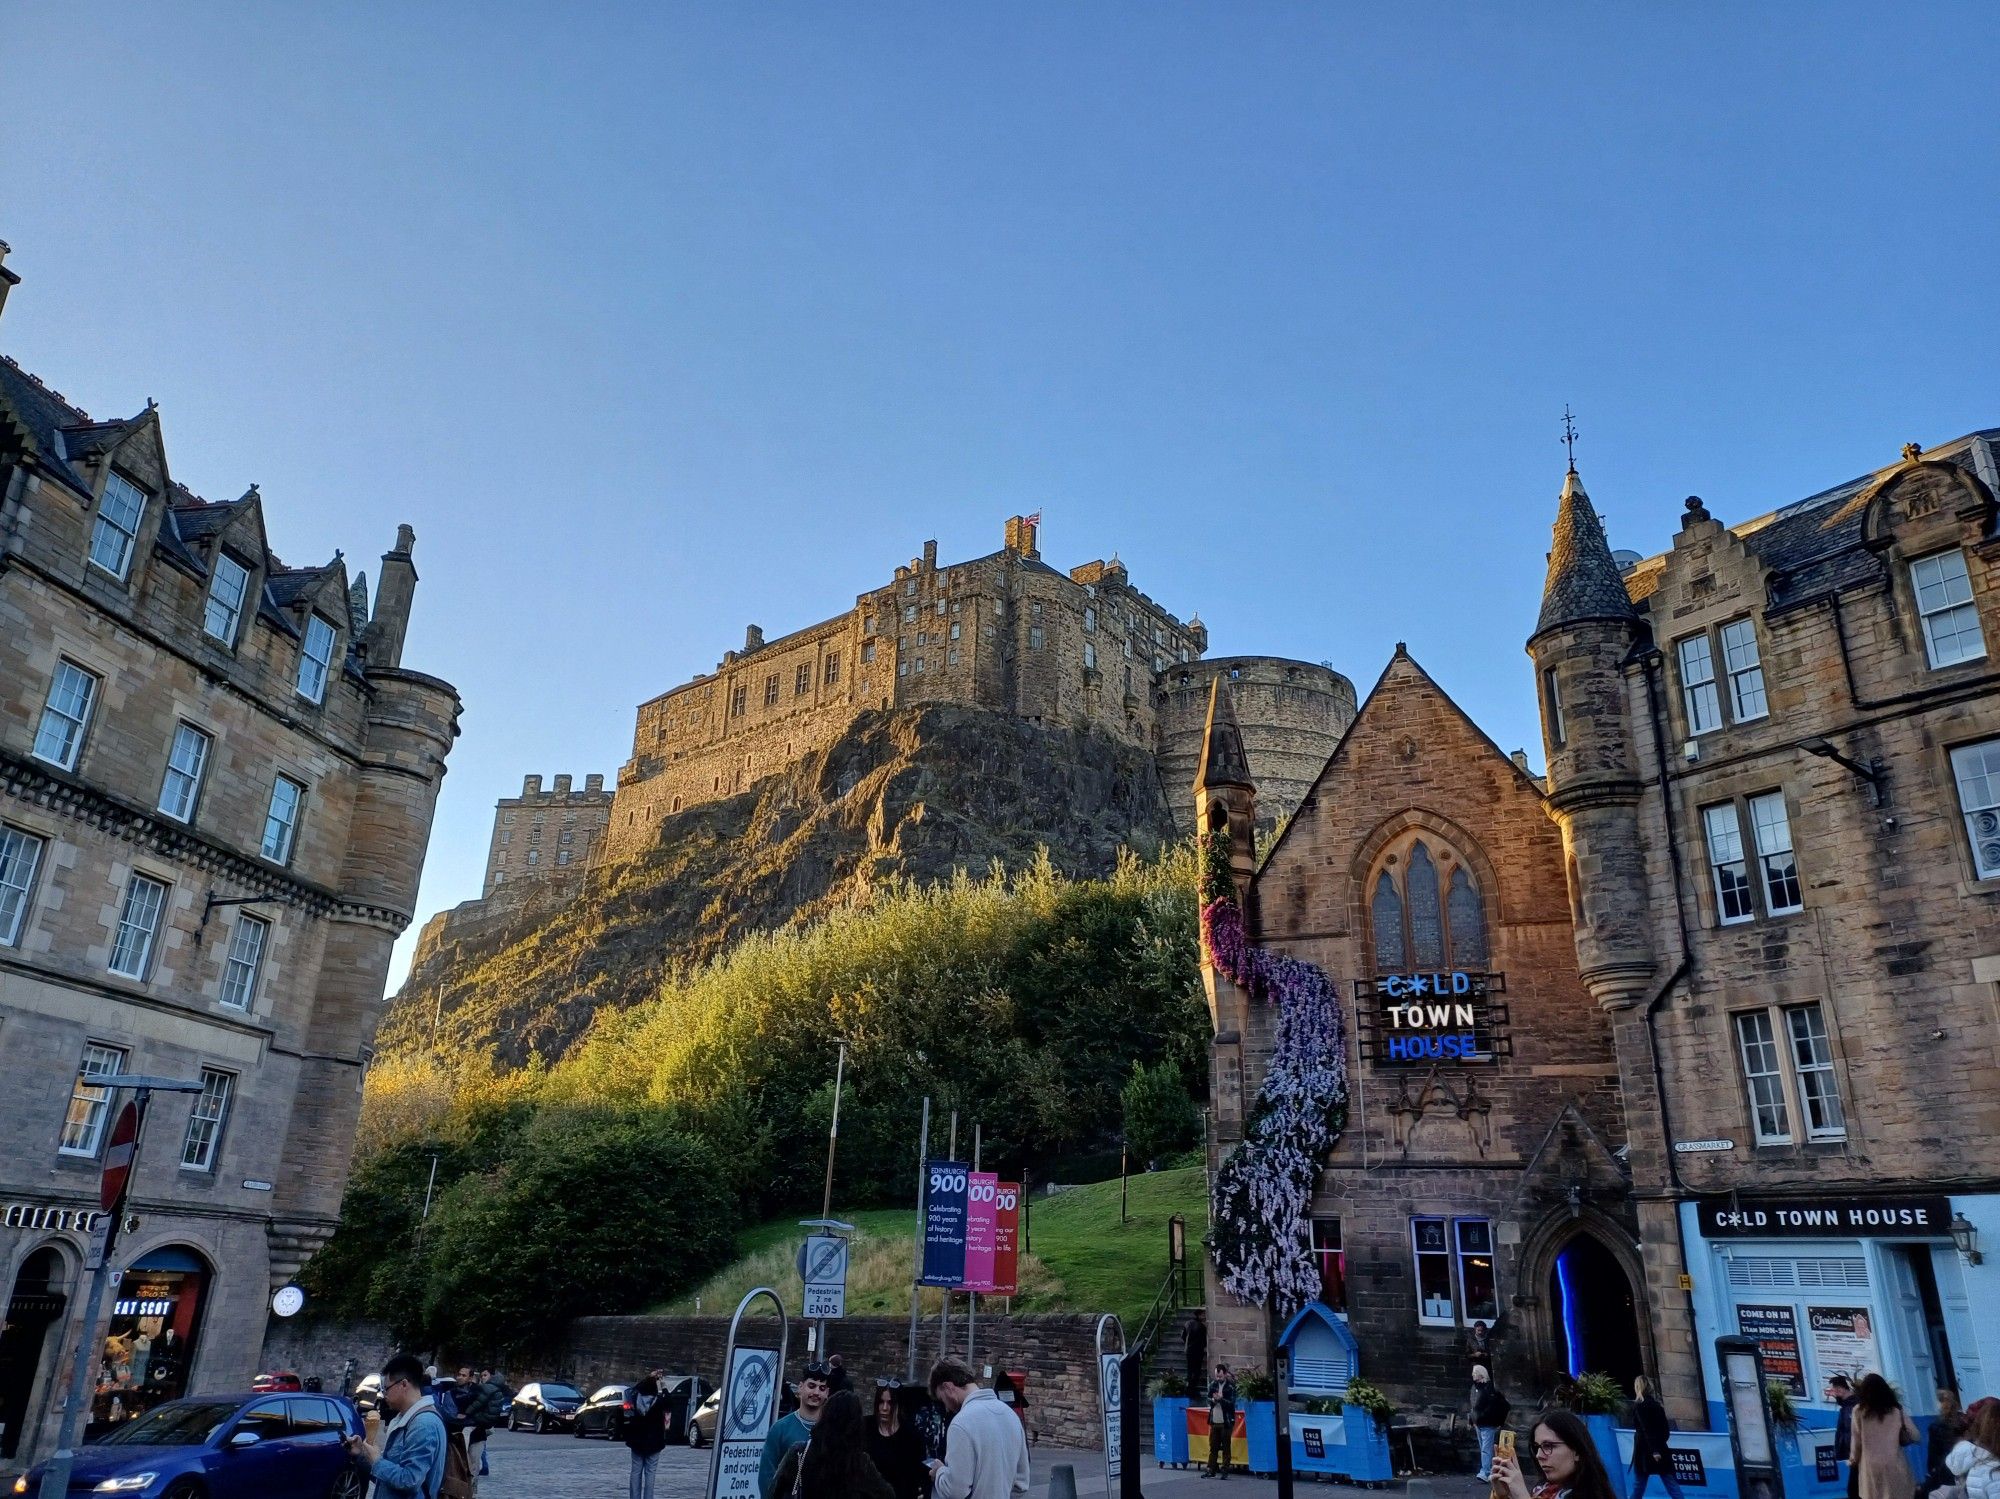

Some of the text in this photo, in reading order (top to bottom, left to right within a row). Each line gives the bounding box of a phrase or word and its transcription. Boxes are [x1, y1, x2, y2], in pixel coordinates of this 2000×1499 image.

[1387, 1003, 1475, 1028] TOWN
[1388, 1034, 1477, 1061] HOUSE
[1678, 1141, 1729, 1151] GRASSMARKET
[930, 1174, 966, 1194] 900
[995, 1194, 1017, 1211] 00
[928, 1205, 962, 1214] Celebrating
[5, 1205, 72, 1231] GREAT
[942, 1217, 958, 1225] years
[1776, 1210, 1839, 1226] TOWN
[1849, 1209, 1929, 1225] HOUSE
[934, 1225, 954, 1233] history
[940, 1235, 963, 1245] heritage
[968, 1243, 992, 1252] heritage
[1680, 1275, 1692, 1289] H
[807, 1287, 841, 1295] Pedestrian
[139, 1301, 170, 1315] SCOT
[809, 1305, 838, 1314] ENDS
[1740, 1309, 1790, 1319] COME ON IN
[1812, 1314, 1853, 1327] Christmas
[723, 1461, 760, 1475] and cycle
[1673, 1462, 1699, 1471] TOWN
[1675, 1472, 1701, 1480] BEER
[730, 1477, 750, 1490] Zone
